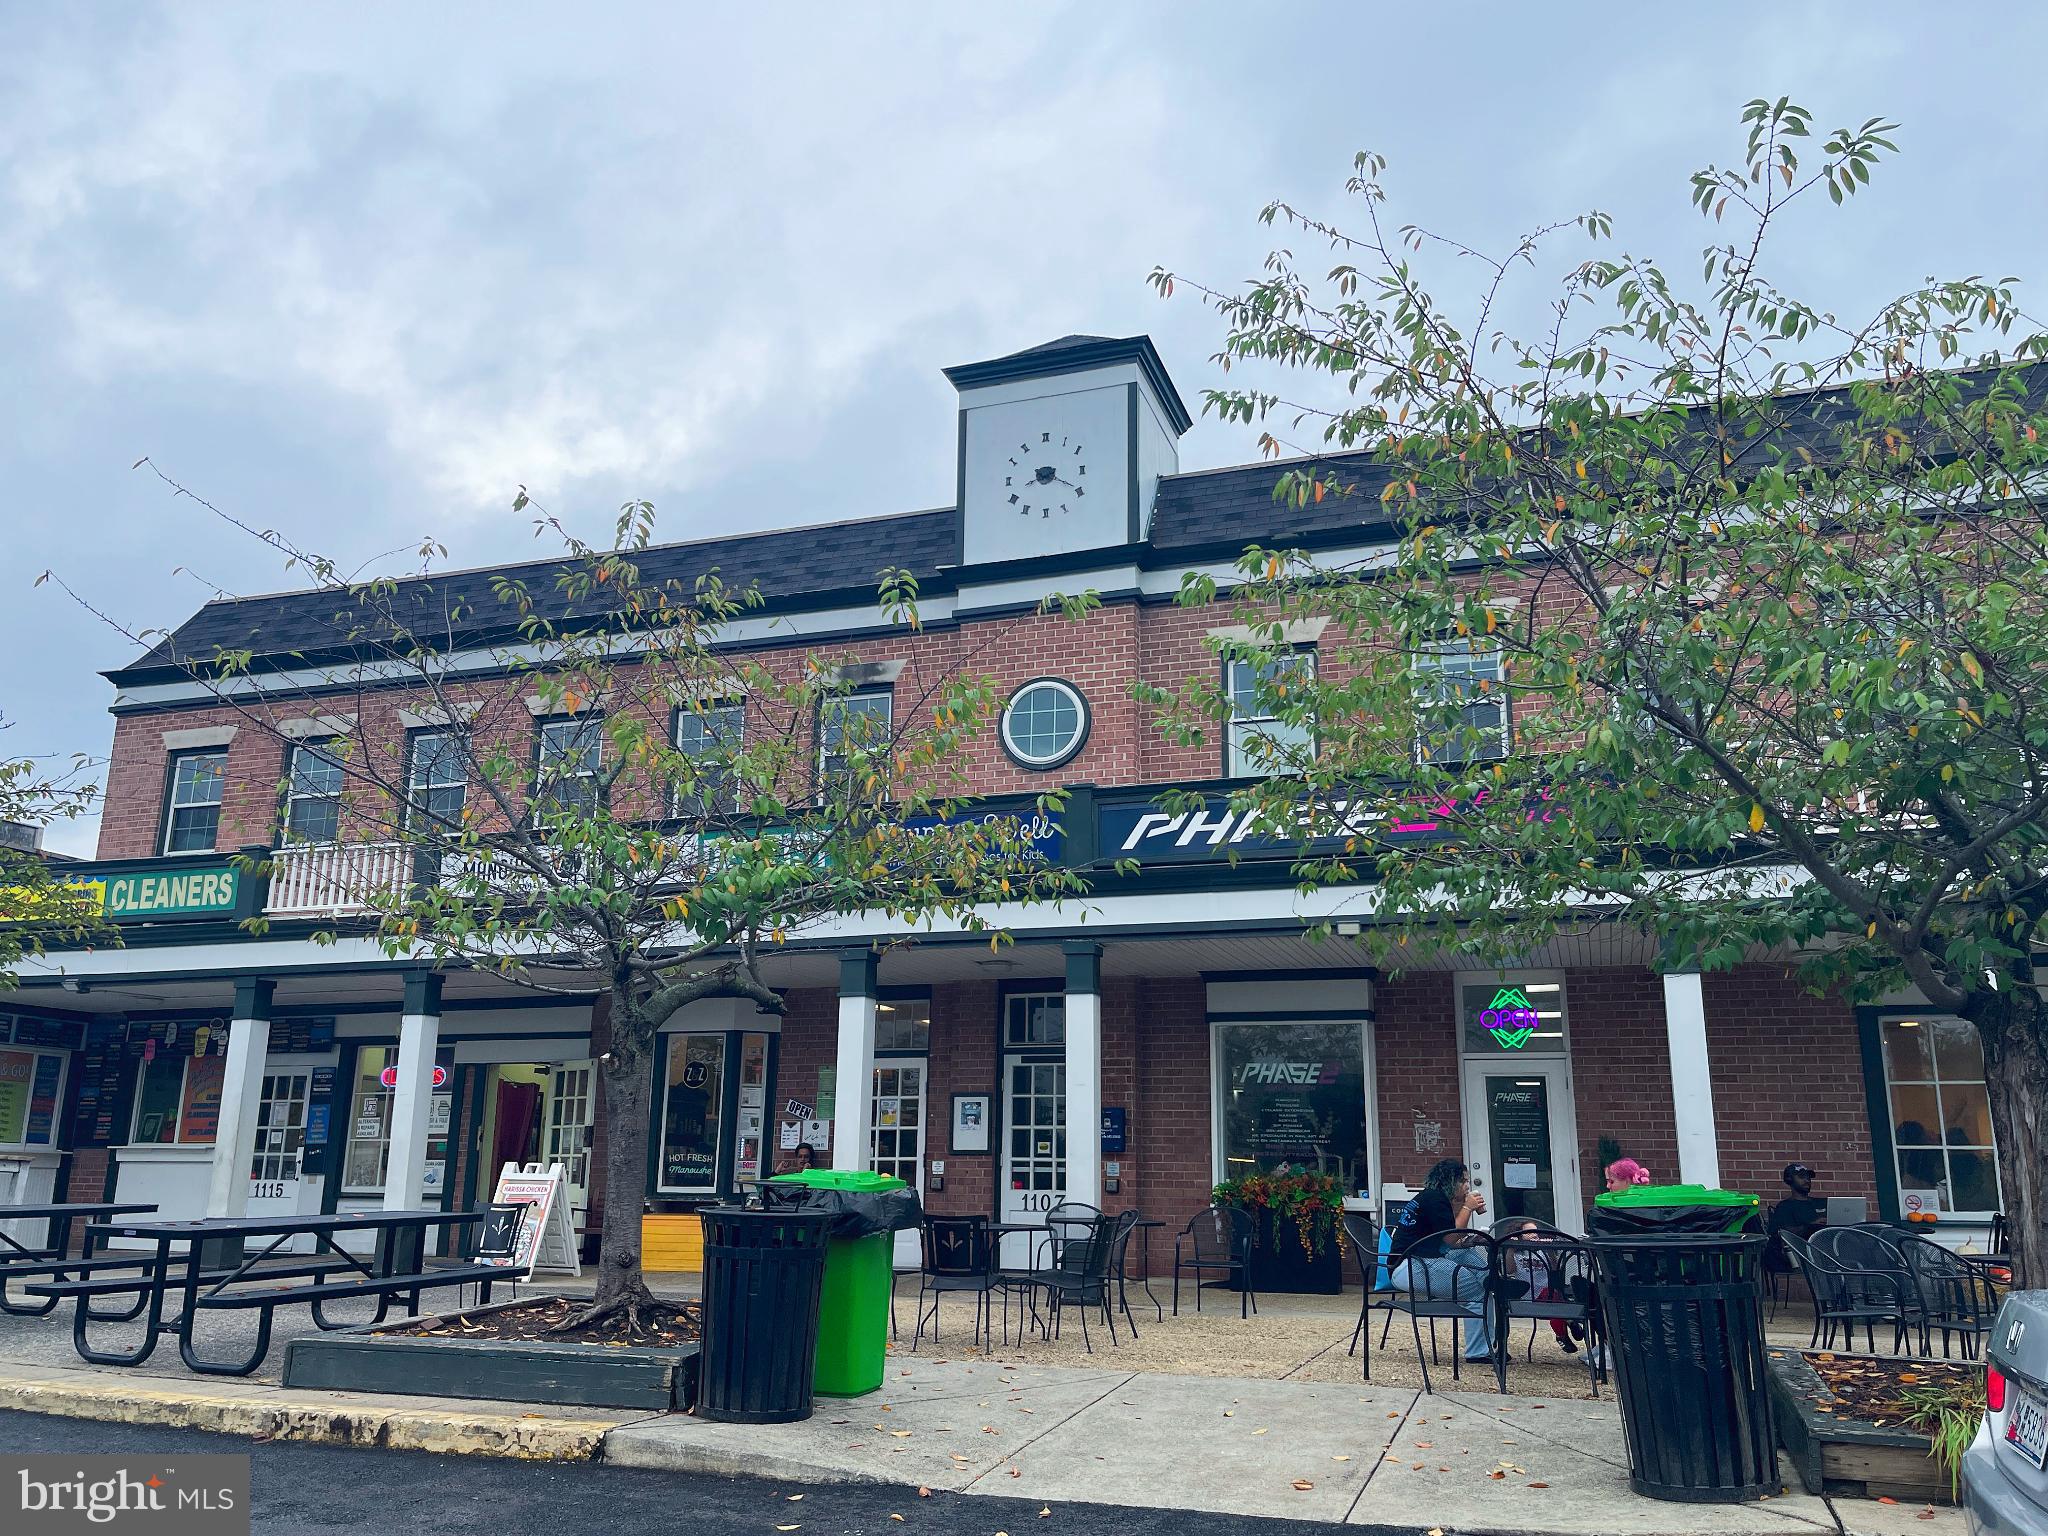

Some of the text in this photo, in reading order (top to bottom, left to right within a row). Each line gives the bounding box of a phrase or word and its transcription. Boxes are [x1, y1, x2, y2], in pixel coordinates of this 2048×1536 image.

[112, 872, 233, 912] CLEANERS
[1480, 1008, 1538, 1028] OPEN
[788, 1101, 811, 1119] OPEN
[668, 1153, 713, 1163] HOT FRESH
[254, 1183, 284, 1198] 1115
[503, 1185, 548, 1193] HARISSA CHICKEN
[1021, 1193, 1067, 1212] 1107
